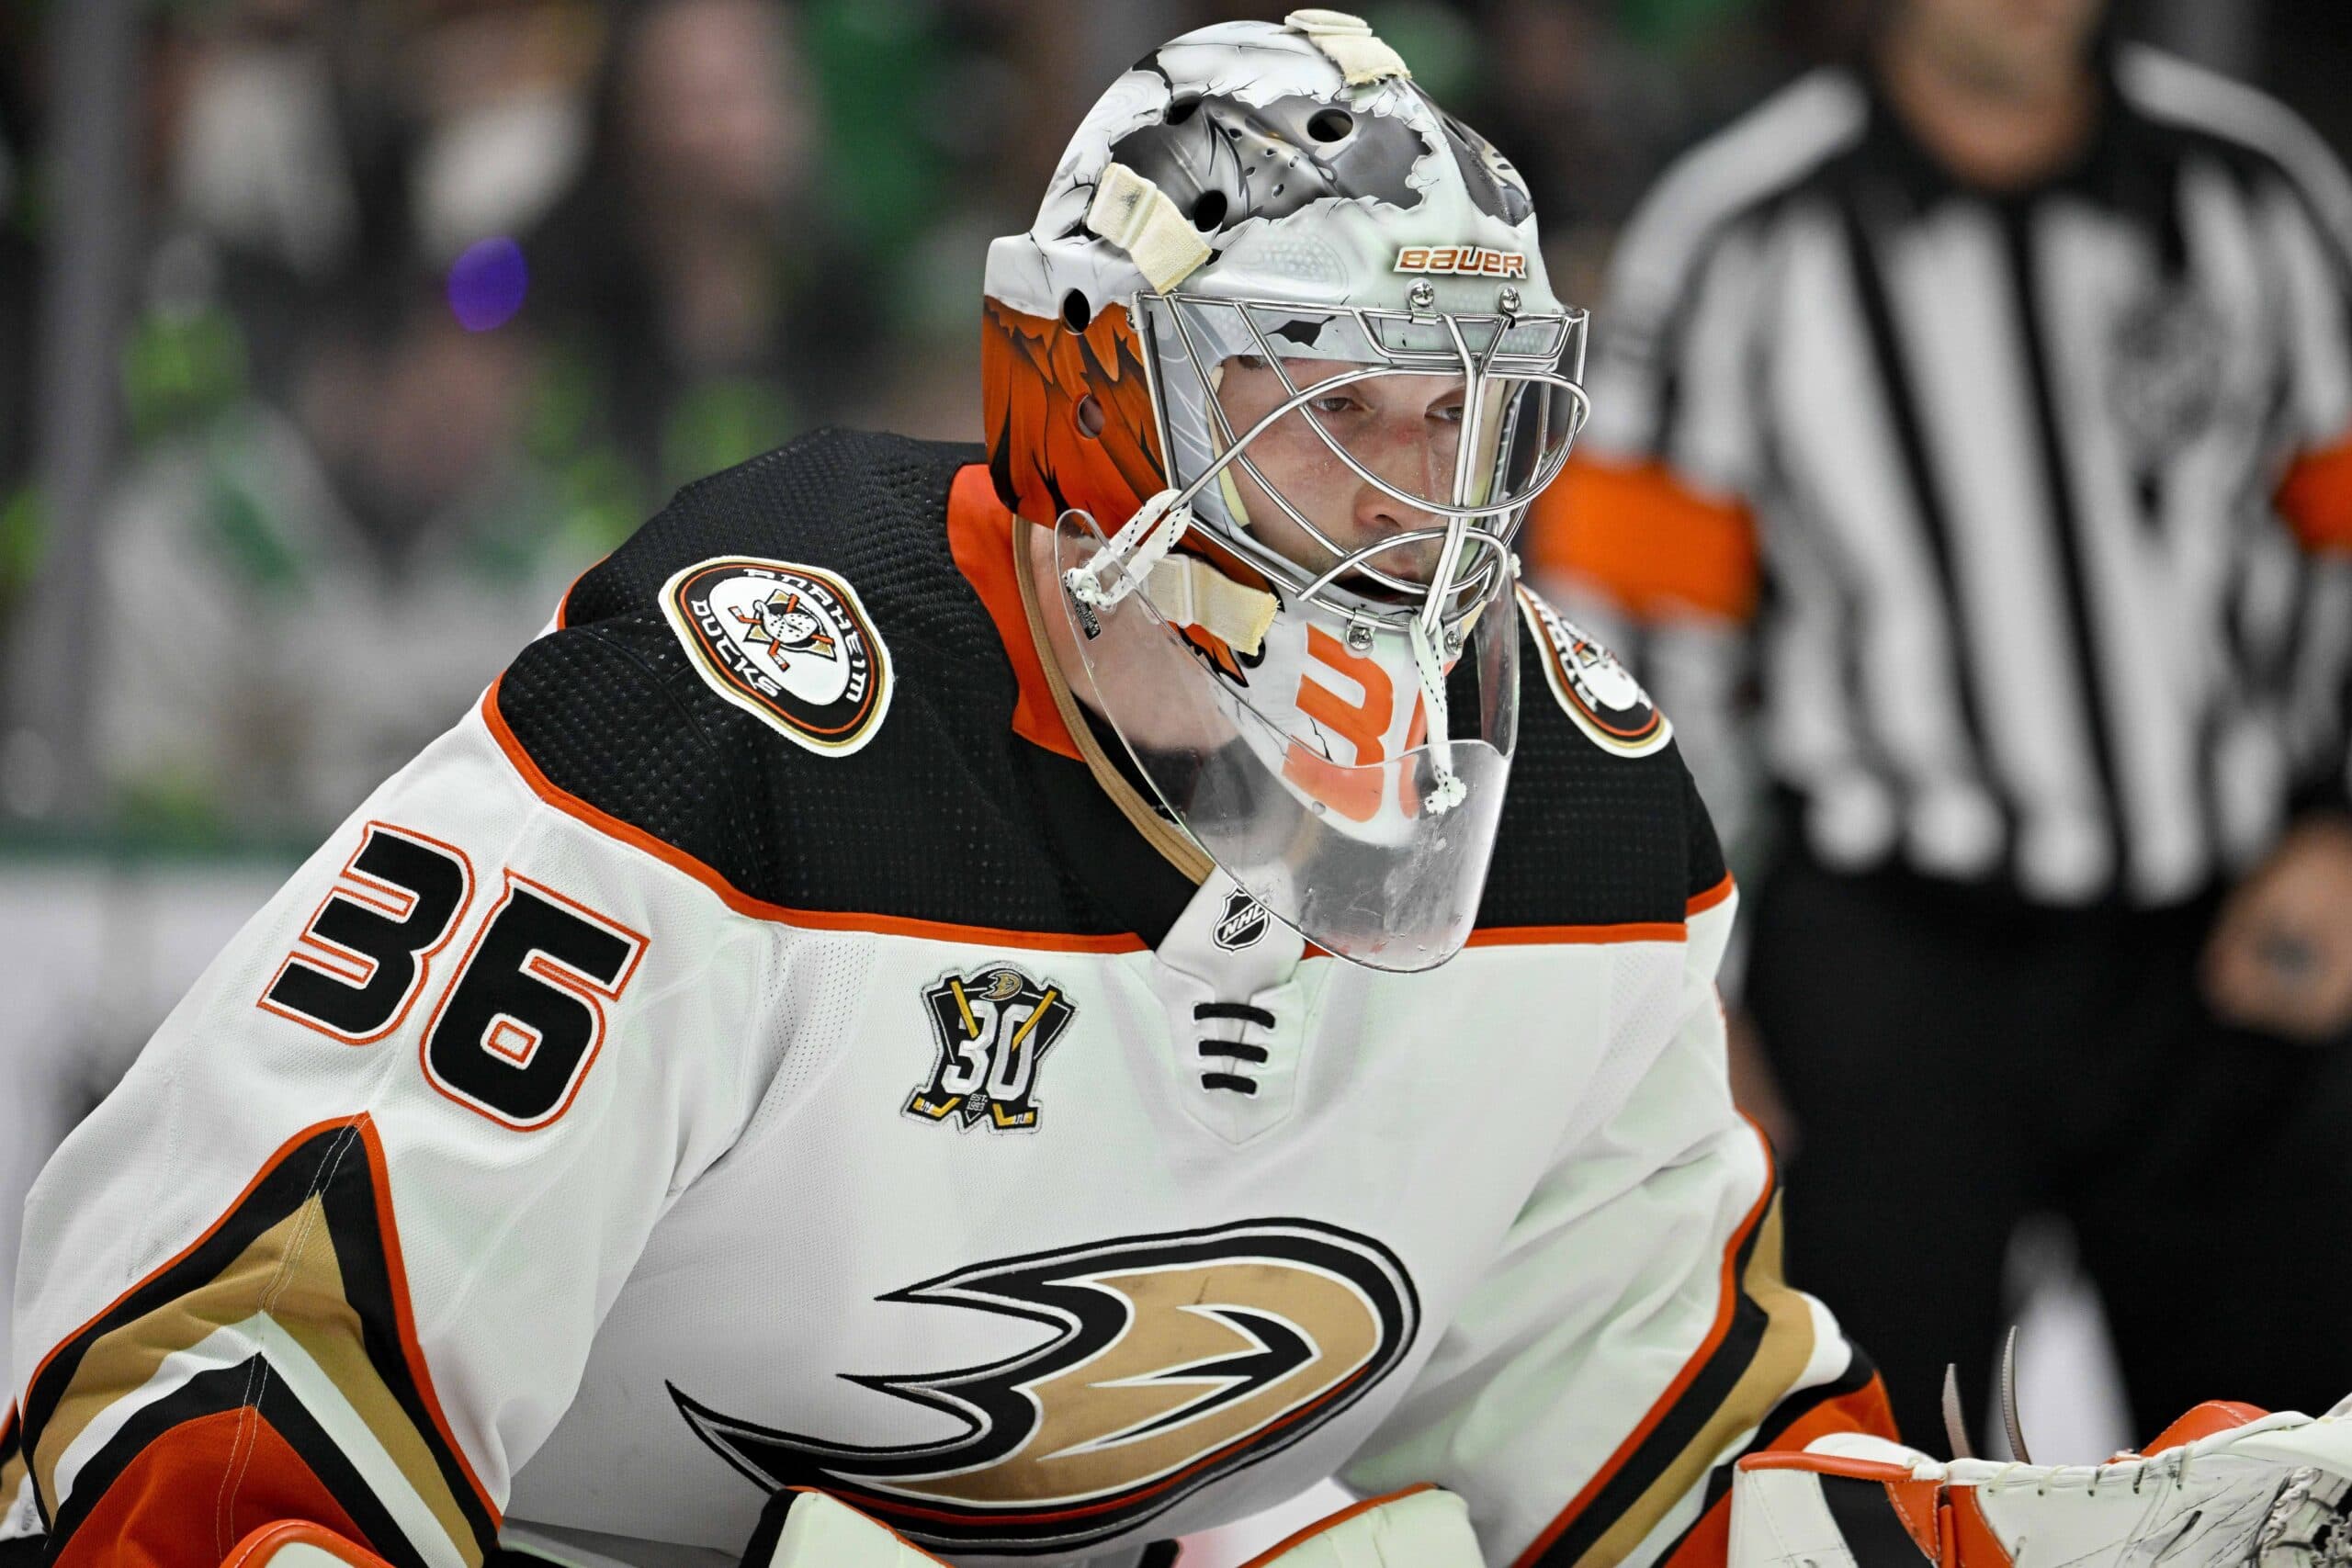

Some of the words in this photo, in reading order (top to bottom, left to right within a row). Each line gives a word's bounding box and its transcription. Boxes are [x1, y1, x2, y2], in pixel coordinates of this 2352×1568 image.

[1396, 247, 1526, 276] BAUER
[690, 599, 782, 698] DUCKS
[742, 568, 867, 704] ANAHEIM
[1221, 903, 1266, 940] NHL
[256, 820, 650, 1133] 36
[941, 999, 1040, 1101] 30
